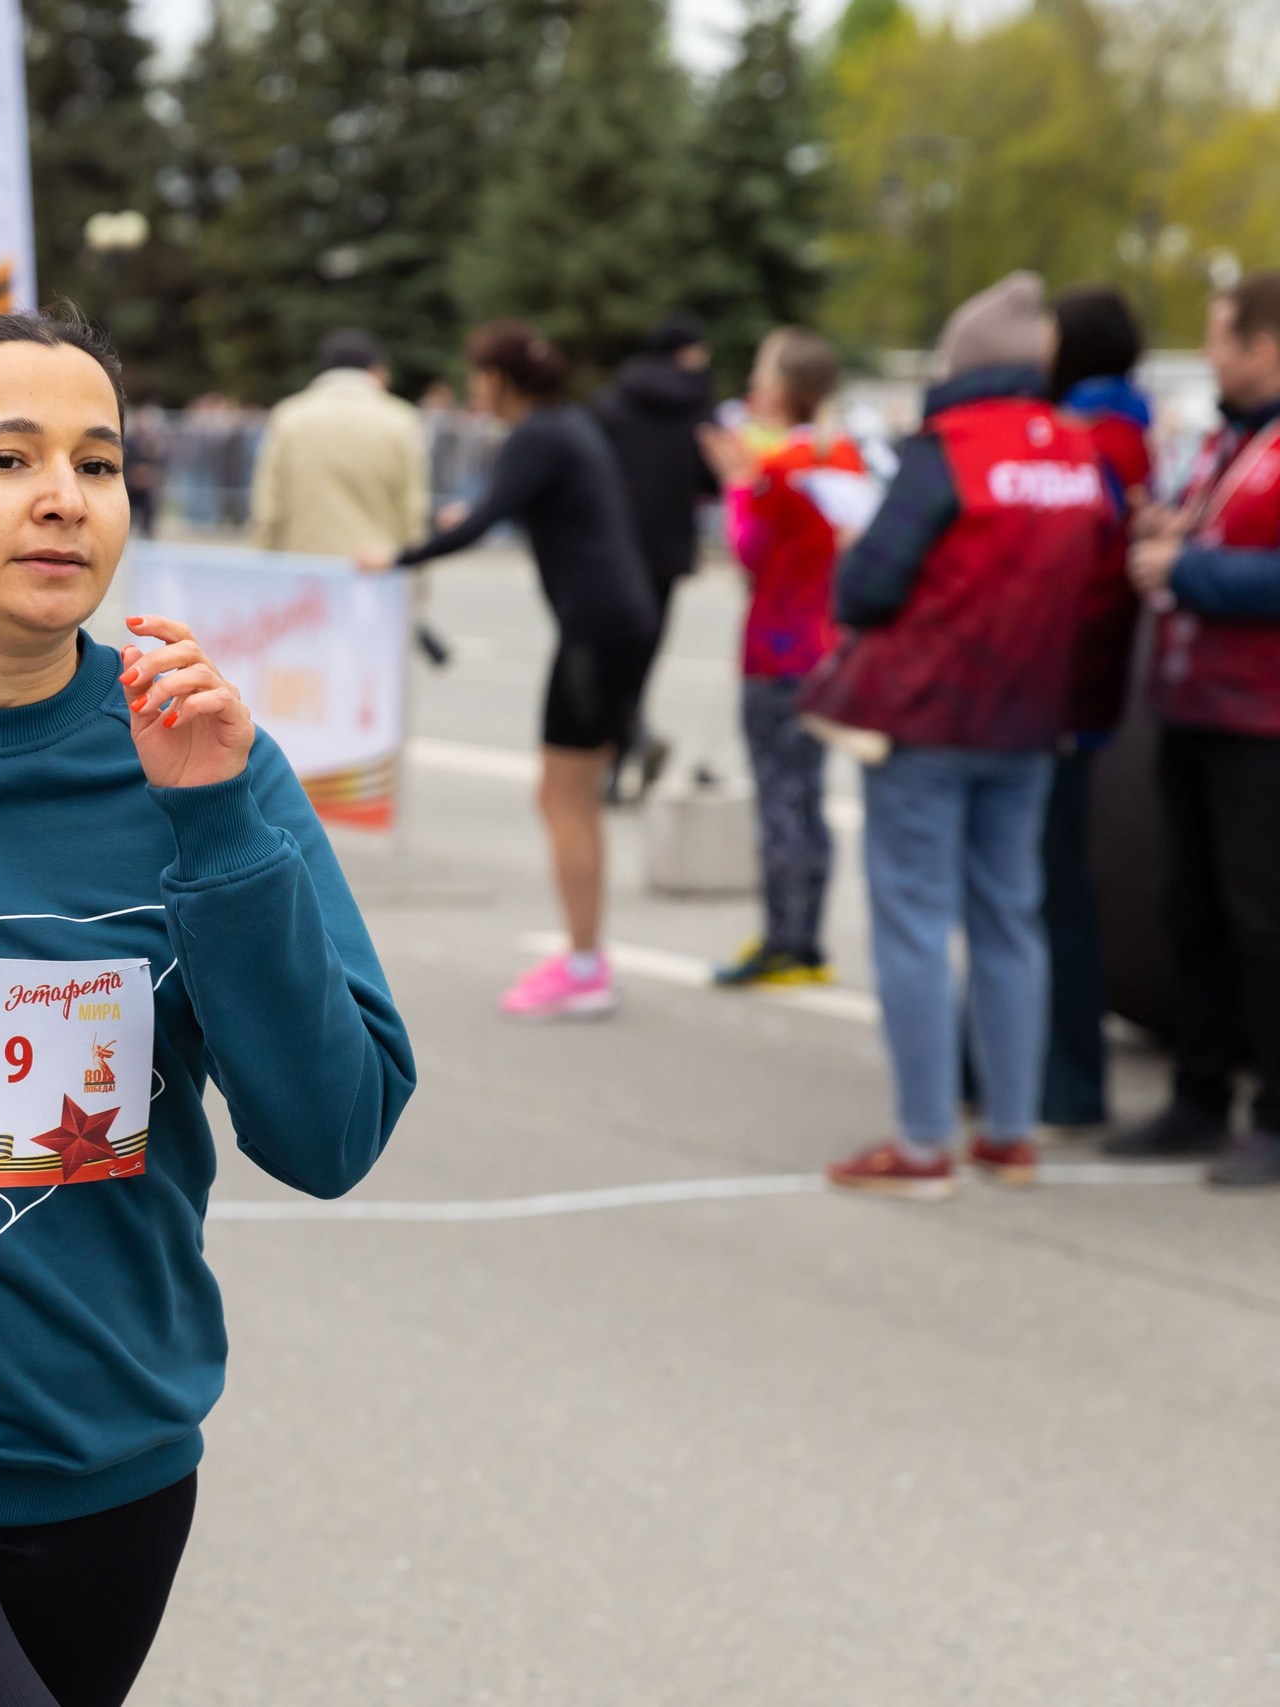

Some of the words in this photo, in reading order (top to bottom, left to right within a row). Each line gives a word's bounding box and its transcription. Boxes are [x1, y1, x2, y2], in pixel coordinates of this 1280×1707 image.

[5, 971, 123, 1020] Эстафета
[78, 1003, 121, 1021] МИРА
[5, 1036, 33, 1083] 9
